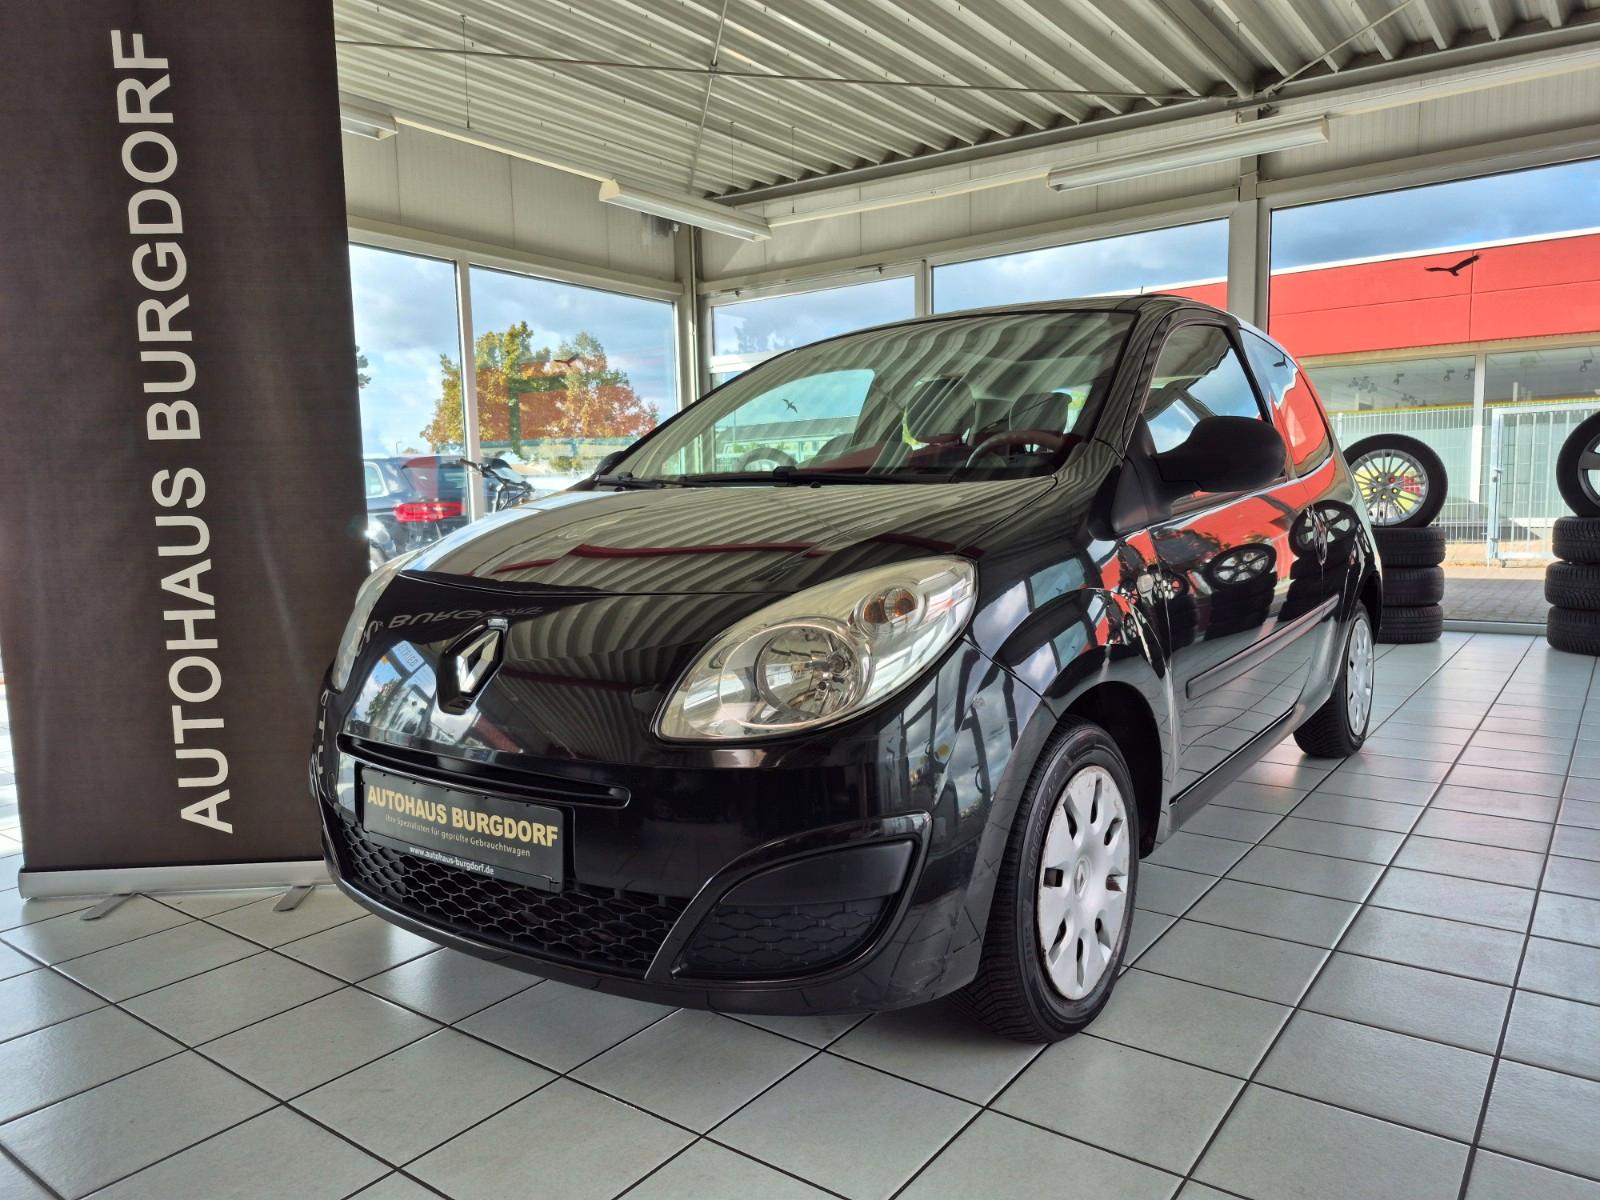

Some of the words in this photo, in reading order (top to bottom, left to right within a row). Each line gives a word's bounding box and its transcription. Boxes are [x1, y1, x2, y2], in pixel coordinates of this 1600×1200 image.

[111, 29, 201, 441] BURGDORF
[151, 467, 233, 834] AUTOHAUS
[367, 785, 447, 825] AUTOHAUS
[451, 806, 559, 847] BURGDORF
[441, 830, 469, 844] geprüfte
[470, 838, 531, 857] Gebrauchtwagen
[409, 846, 495, 875] www.autohaus-burgdorf.de
